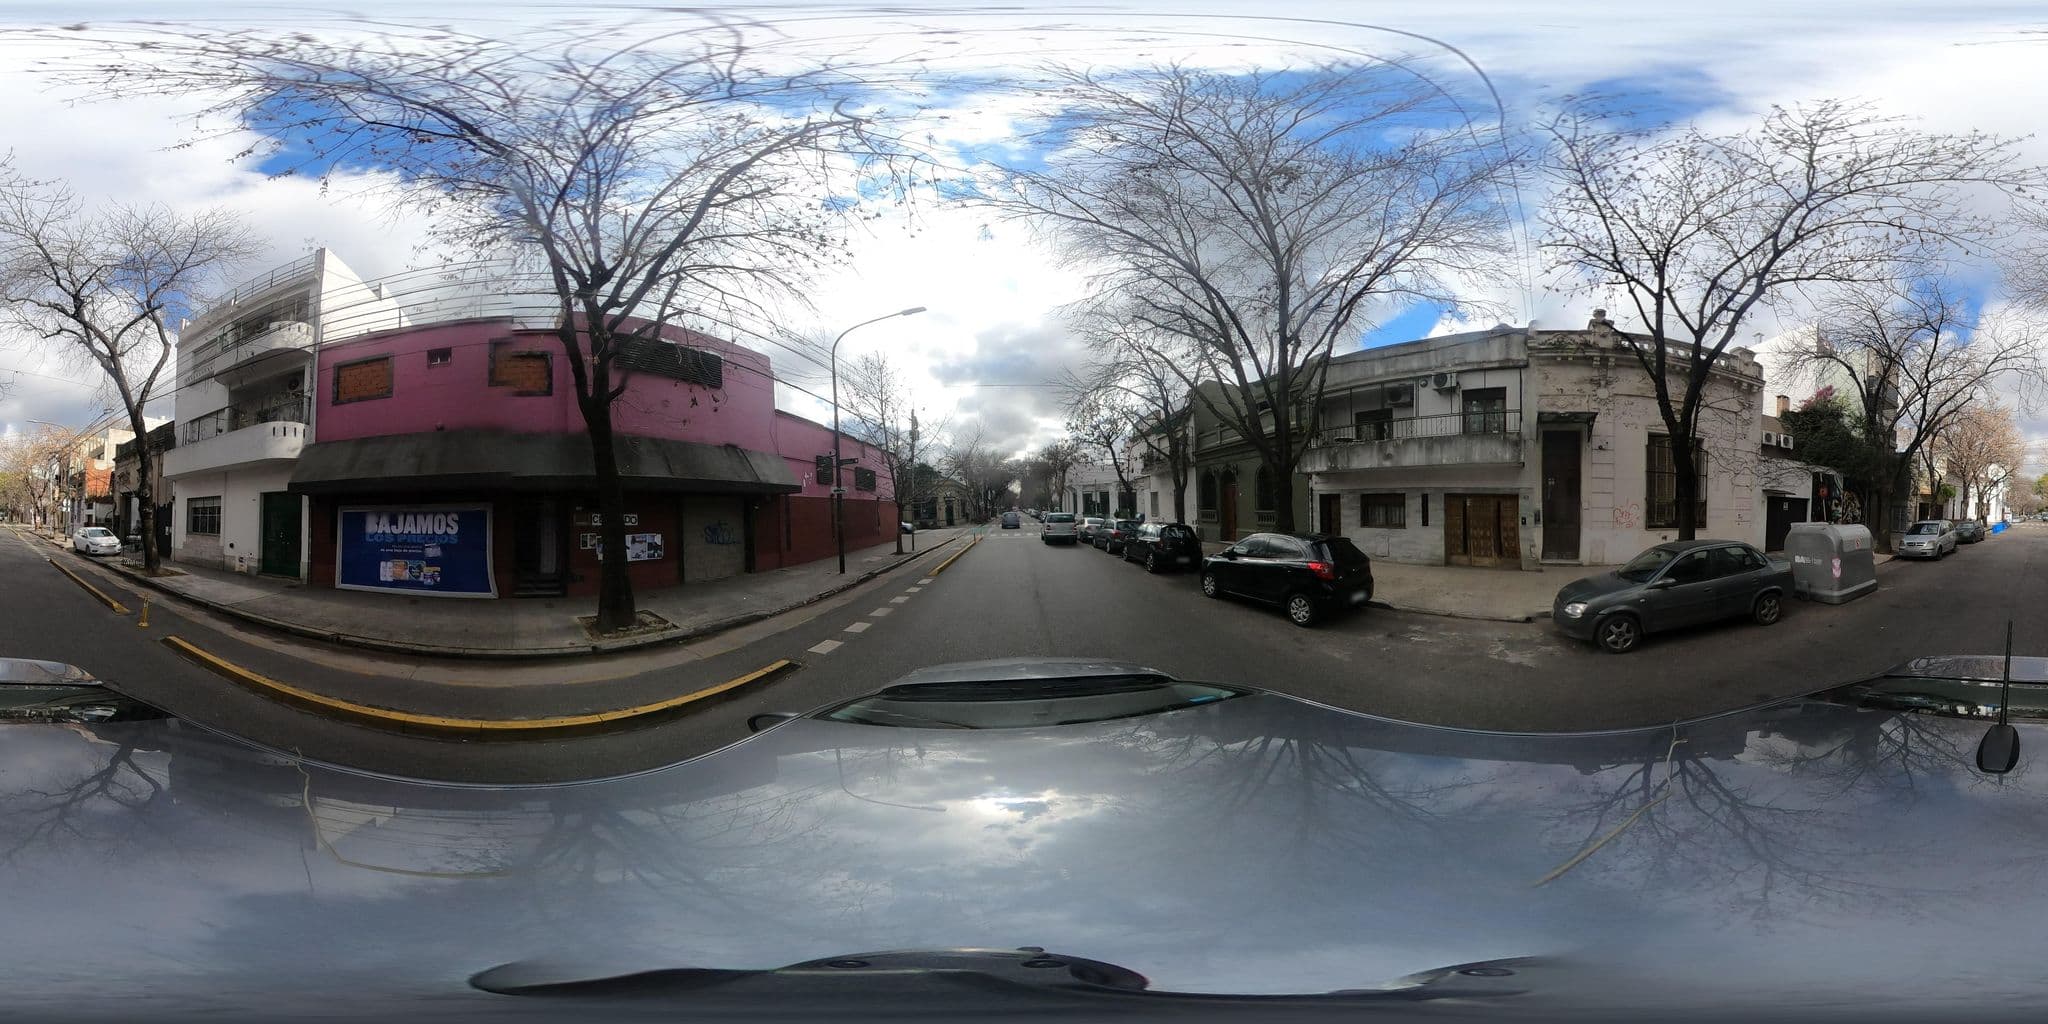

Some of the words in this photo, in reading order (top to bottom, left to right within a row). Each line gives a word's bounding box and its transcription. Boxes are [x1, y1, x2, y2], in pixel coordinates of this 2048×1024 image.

[365, 512, 459, 535] BAJAMOS
[365, 533, 394, 543] LOS
[397, 534, 459, 544] PRECIOS
